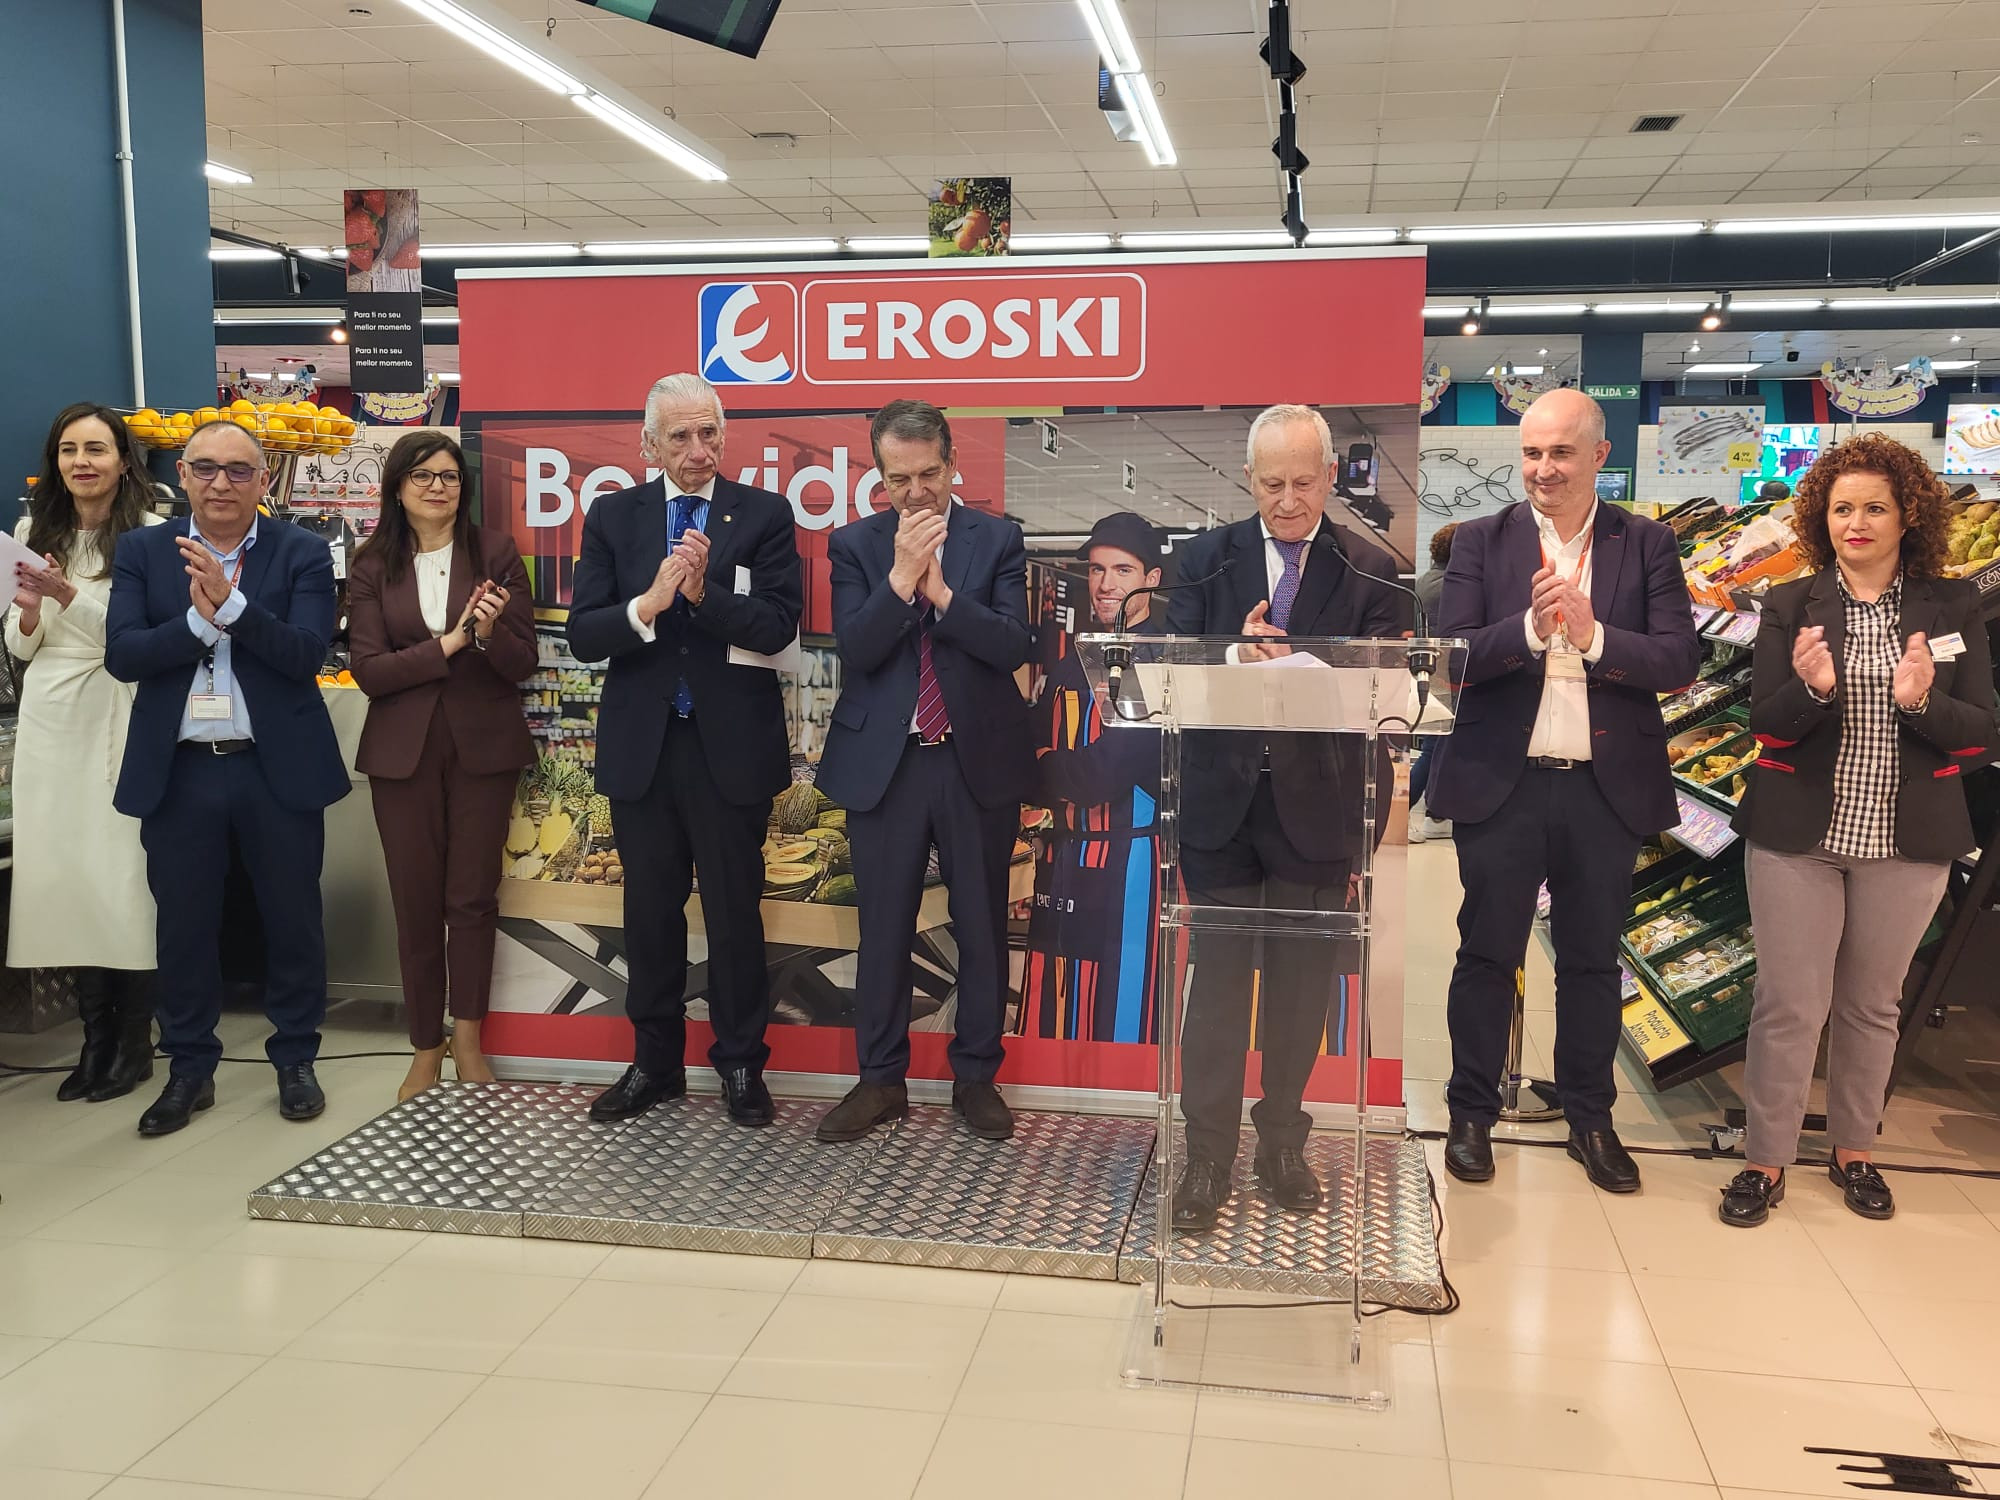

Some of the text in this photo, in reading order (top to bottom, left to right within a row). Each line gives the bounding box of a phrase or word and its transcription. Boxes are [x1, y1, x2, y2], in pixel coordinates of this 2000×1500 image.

[354, 323, 376, 331] mellor
[826, 296, 1120, 360] EROSKI
[355, 359, 378, 367] mellor
[1587, 387, 1622, 397] SALIDA
[1643, 1009, 1671, 1039] Producto
[1629, 1022, 1650, 1045] Ahorro
